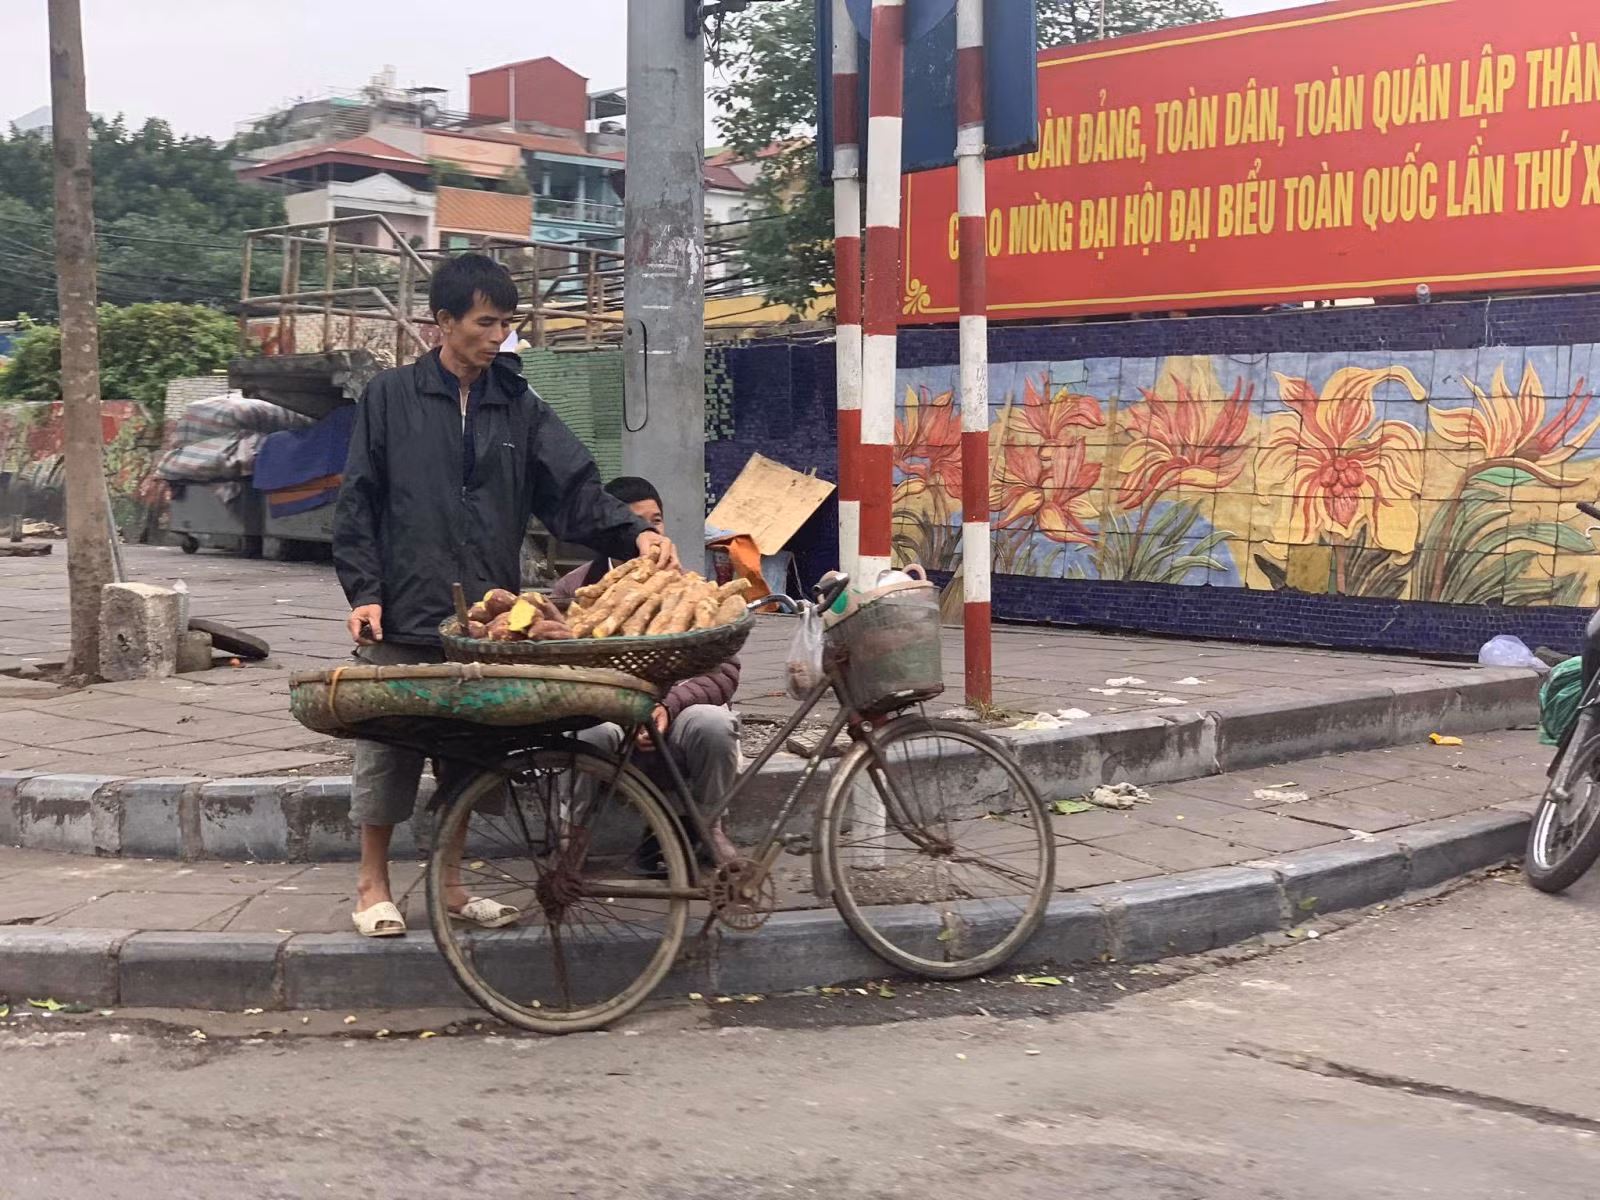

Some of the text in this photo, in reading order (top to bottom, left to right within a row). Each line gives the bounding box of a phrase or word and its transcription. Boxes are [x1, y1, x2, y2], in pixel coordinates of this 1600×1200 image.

[1077, 88, 1147, 164] ĐẢNG,
[1155, 86, 1218, 154] TOÀN
[1224, 77, 1285, 147] DÂN,
[1295, 65, 1365, 138] TOÀN
[1372, 53, 1451, 134] QUÂN
[1459, 43, 1516, 129] LẬP
[948, 207, 1003, 261] CO
[1008, 191, 1073, 255] MỪNG
[1079, 196, 1117, 260] ĐẠI
[1123, 181, 1163, 256] HỘI
[1169, 186, 1211, 252] ĐẠI
[1217, 157, 1276, 237] BIỂU
[1283, 161, 1354, 232] TOÀN
[1361, 142, 1438, 231] QUỐC
[1446, 135, 1505, 217] LẦN
[1514, 129, 1578, 211] THỨ
